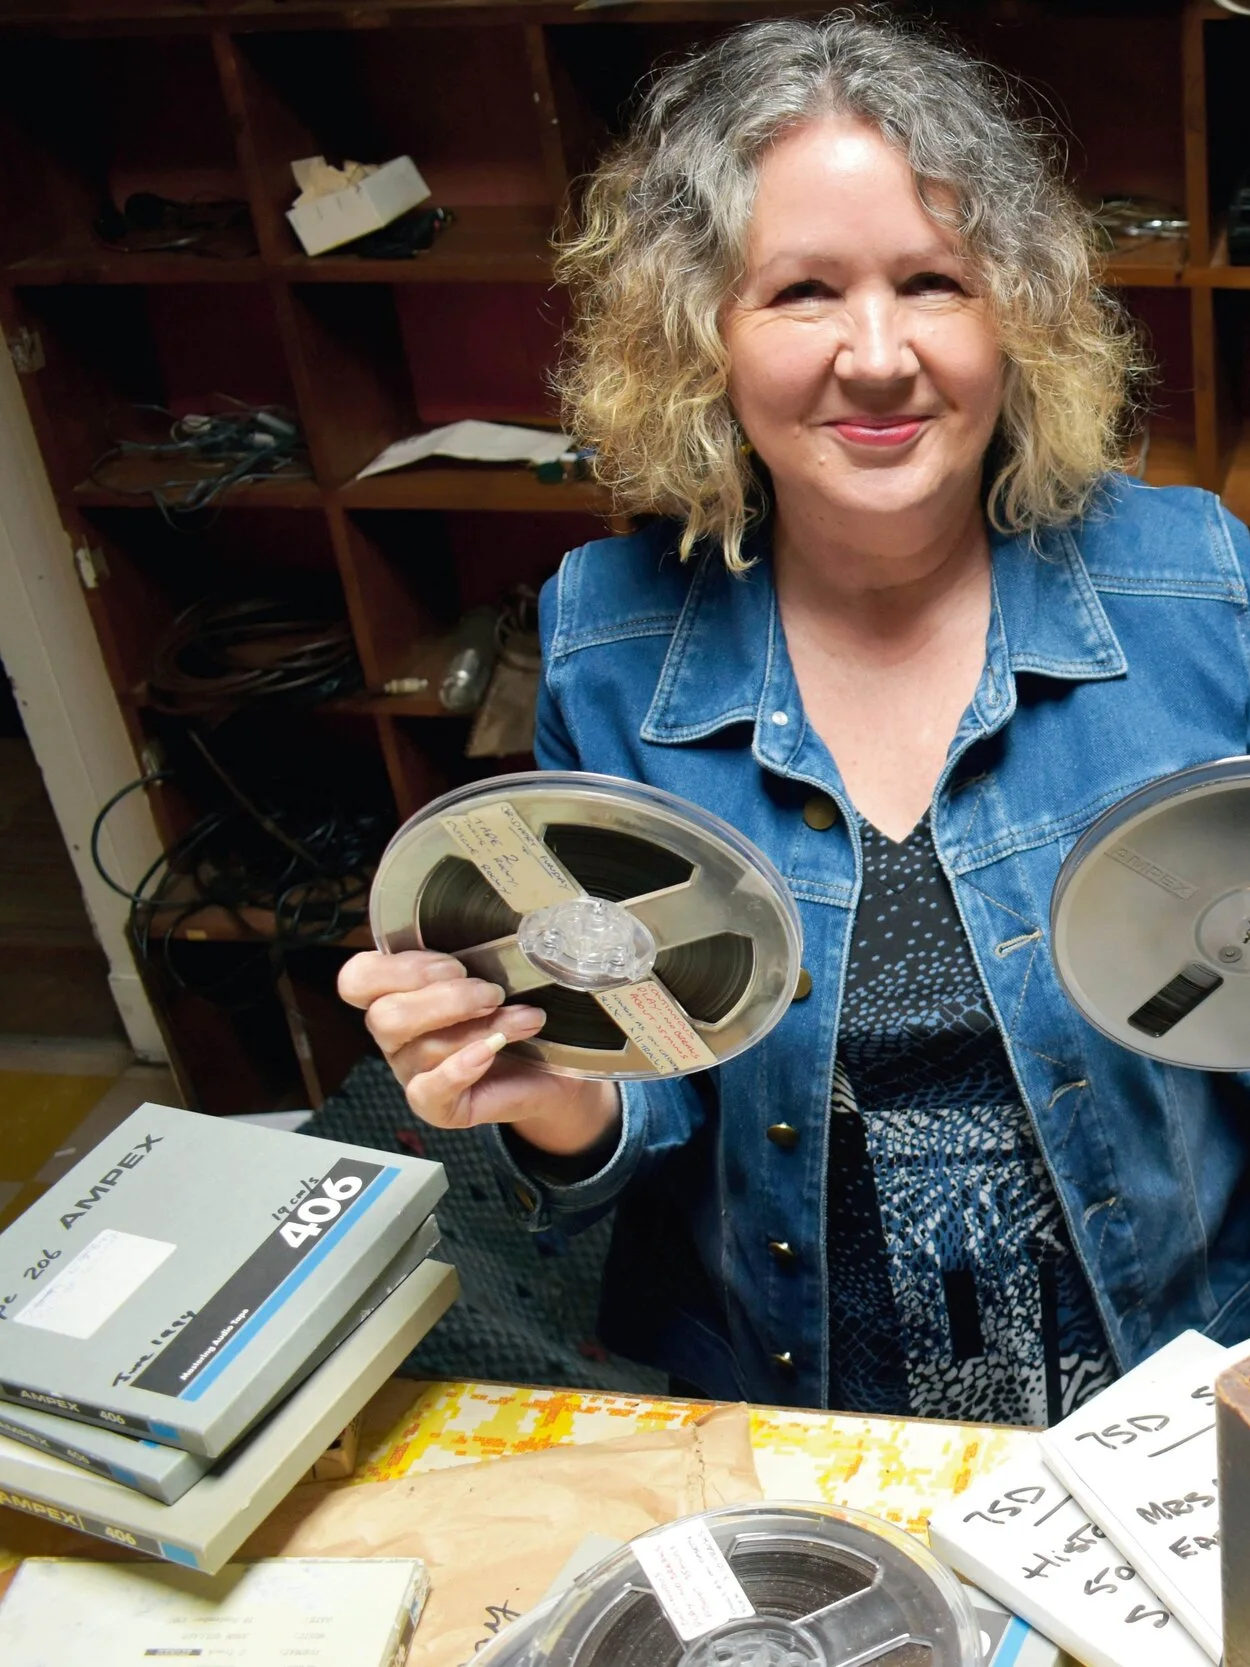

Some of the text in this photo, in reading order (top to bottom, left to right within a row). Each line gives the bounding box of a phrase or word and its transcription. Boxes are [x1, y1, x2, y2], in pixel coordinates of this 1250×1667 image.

[60, 1134, 164, 1230] AMPEX
[279, 1176, 363, 1249] 406
[23, 1248, 62, 1281] 206
[180, 1308, 249, 1381] Mastering Audio Tape
[20, 1389, 126, 1425] AMPEX 406
[1074, 1414, 1170, 1451] 7SD
[962, 1485, 1047, 1525] 7SD
[104, 1525, 137, 1546] 406
